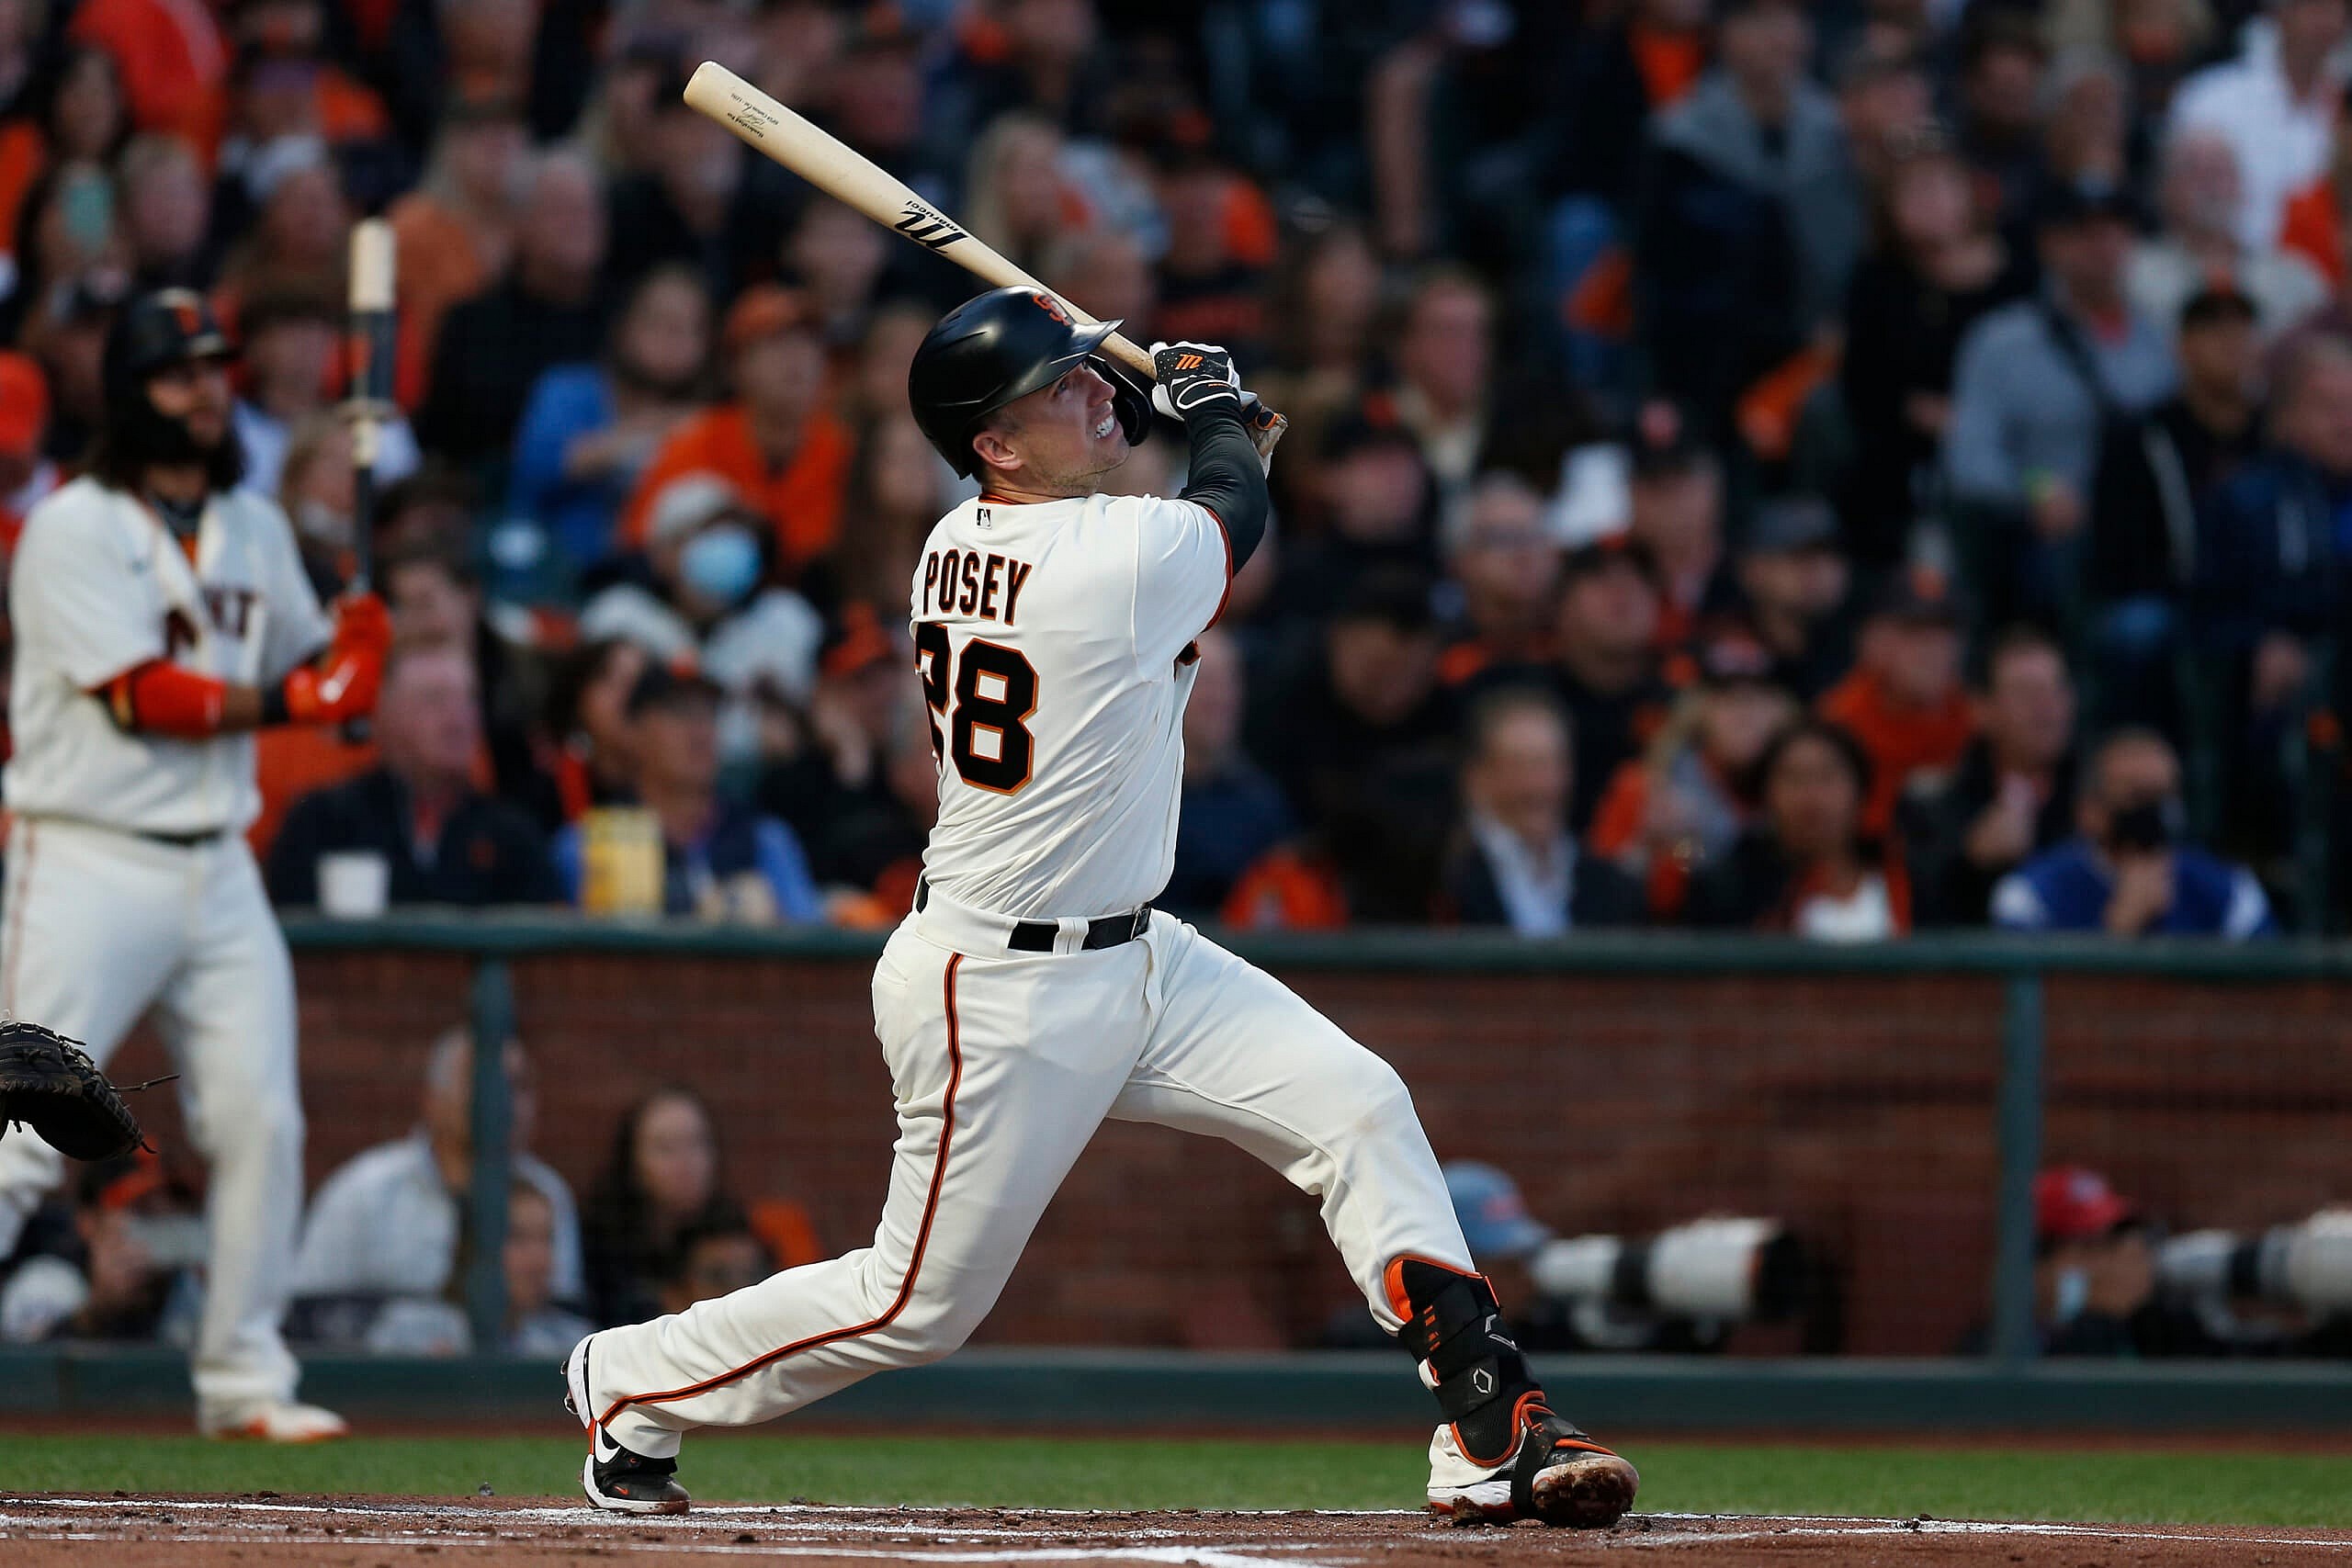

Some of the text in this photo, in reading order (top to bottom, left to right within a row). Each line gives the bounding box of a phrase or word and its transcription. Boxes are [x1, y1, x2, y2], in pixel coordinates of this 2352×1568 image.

[905, 199, 959, 232] marucci
[922, 548, 1033, 627] POSEY
[914, 621, 1040, 797] 28
